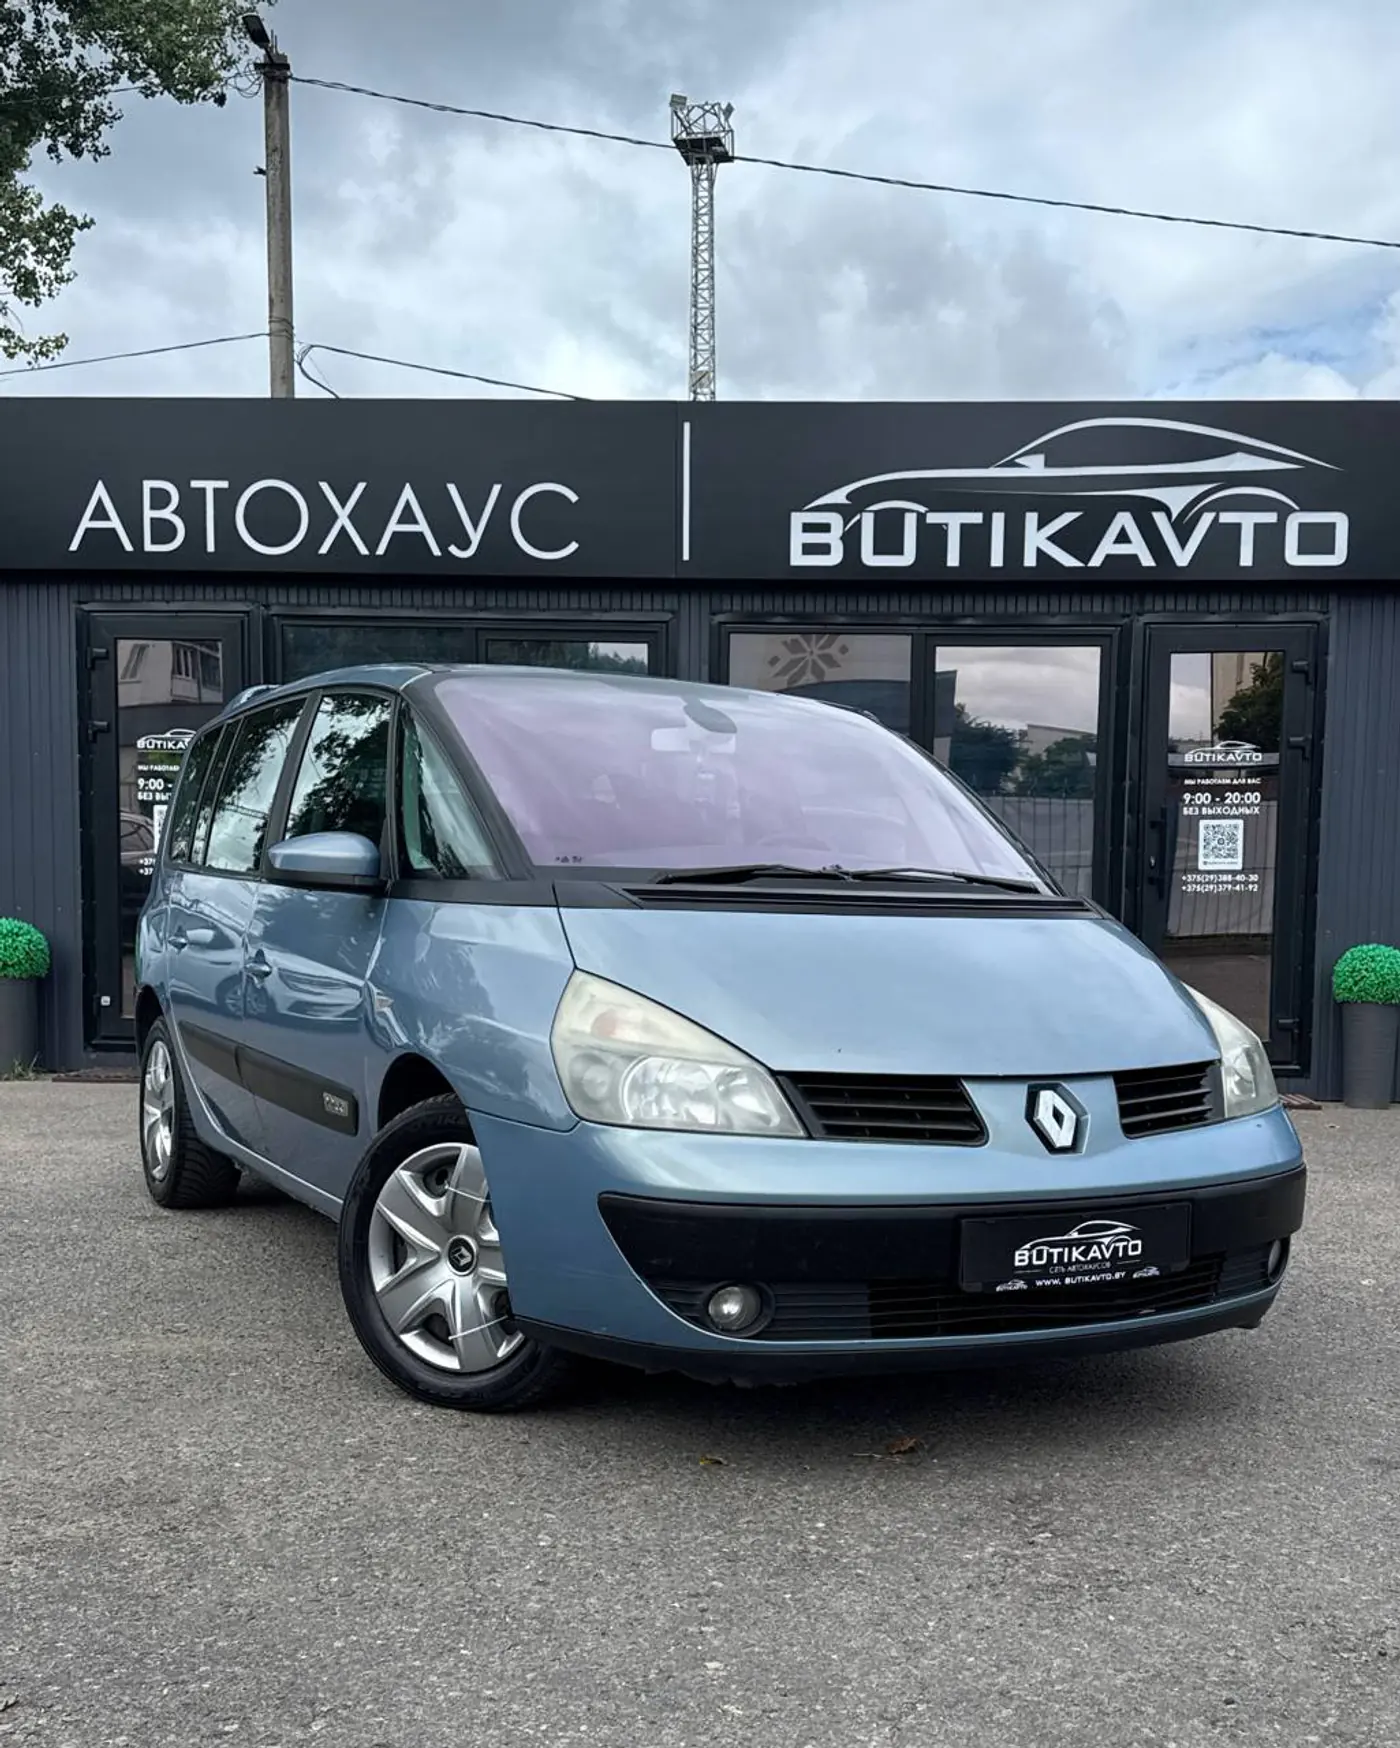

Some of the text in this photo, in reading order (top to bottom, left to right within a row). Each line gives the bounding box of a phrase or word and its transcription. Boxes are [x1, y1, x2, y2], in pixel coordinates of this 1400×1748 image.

[68, 480, 580, 559] АВТОХАУС
[789, 510, 1350, 568] BUTIKAVTO
[1184, 752, 1262, 762] BUTIKAVTO
[137, 778, 164, 790] 9:00
[137, 792, 153, 800] БЕЗ
[1183, 792, 1212, 805] 9:00
[1224, 792, 1261, 804] 20:00
[1183, 806, 1260, 815] БЕЗ ВЫХОДНЫХ
[1014, 1240, 1142, 1266] BUTIKAVTO
[1064, 1271, 1126, 1284] BUTIKAVTO.BY
